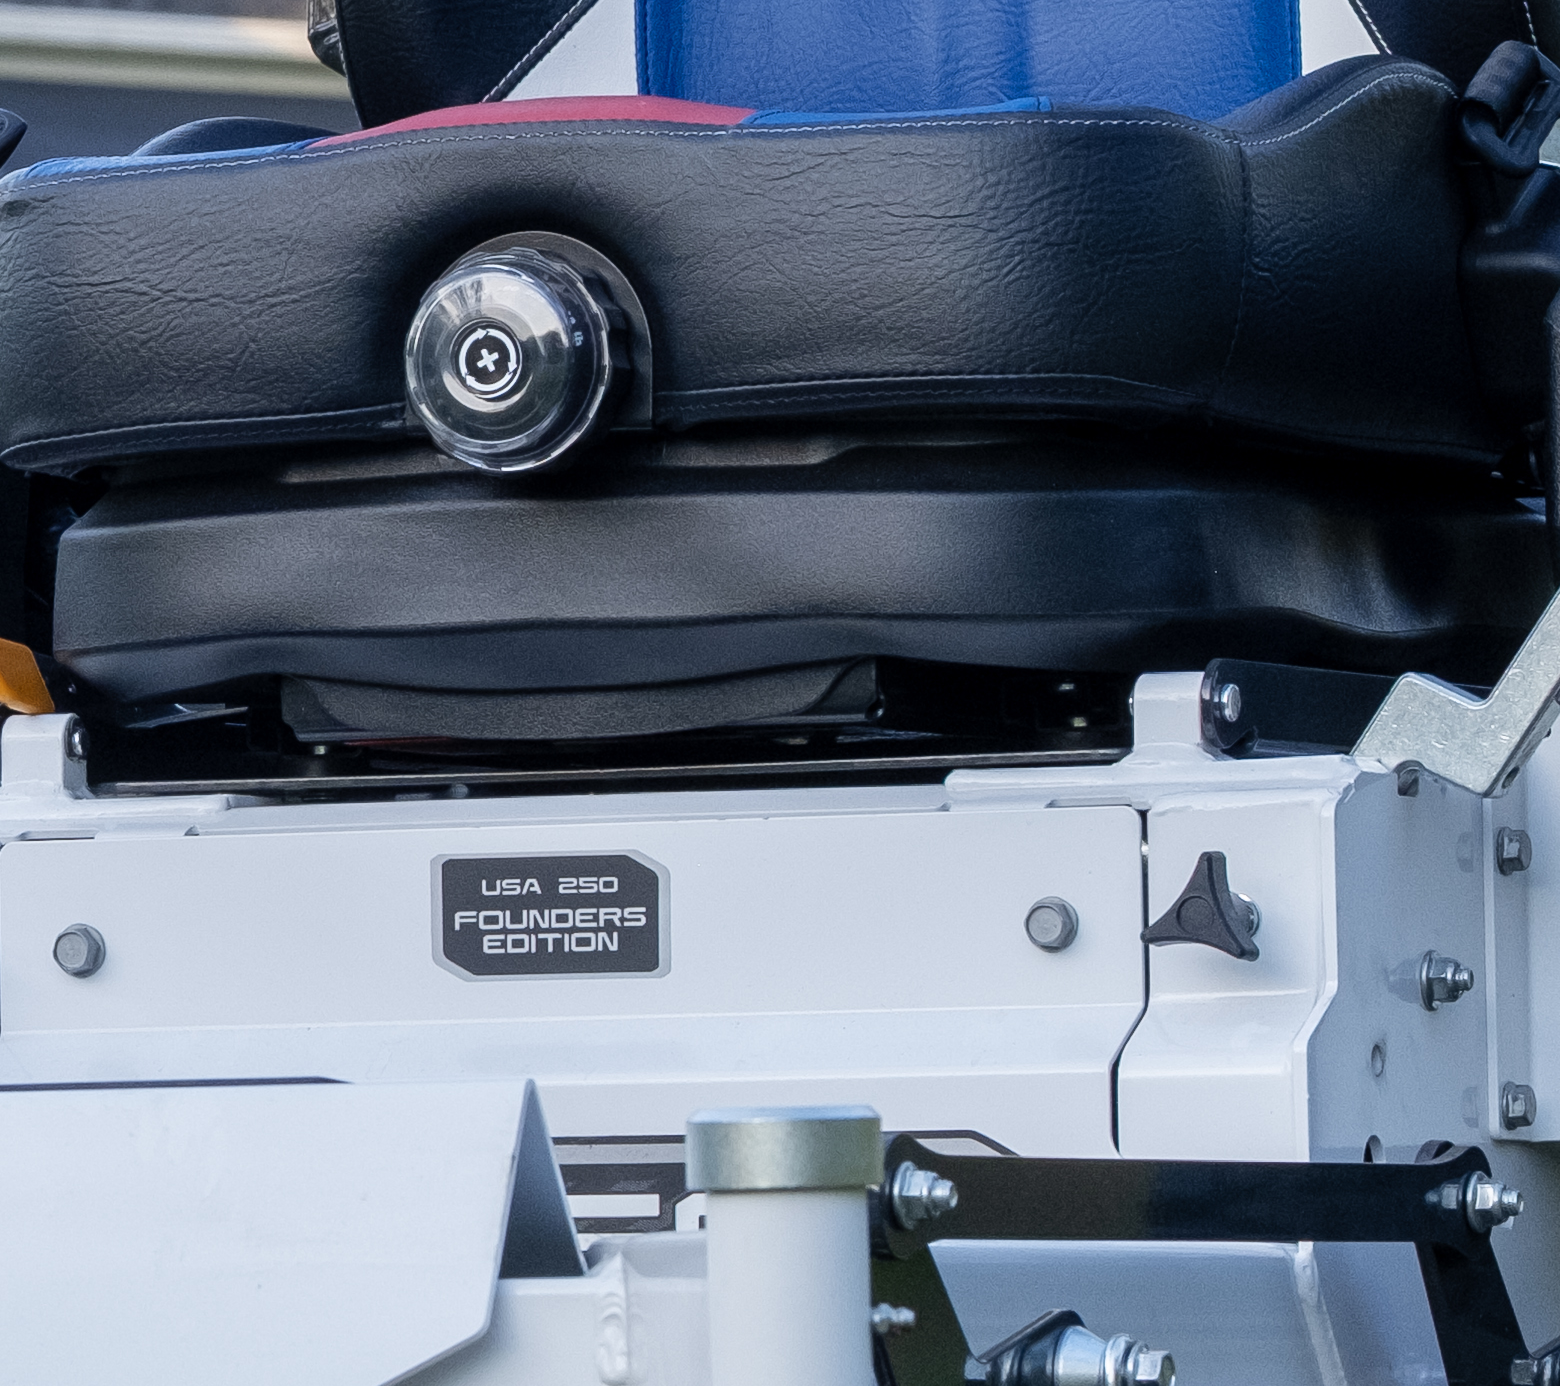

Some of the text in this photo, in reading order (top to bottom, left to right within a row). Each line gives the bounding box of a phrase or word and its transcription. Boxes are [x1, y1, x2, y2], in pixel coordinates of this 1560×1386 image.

[481, 875, 619, 897] USA 250
[454, 906, 647, 931] FOUNDERS
[482, 931, 619, 954] EDITION
